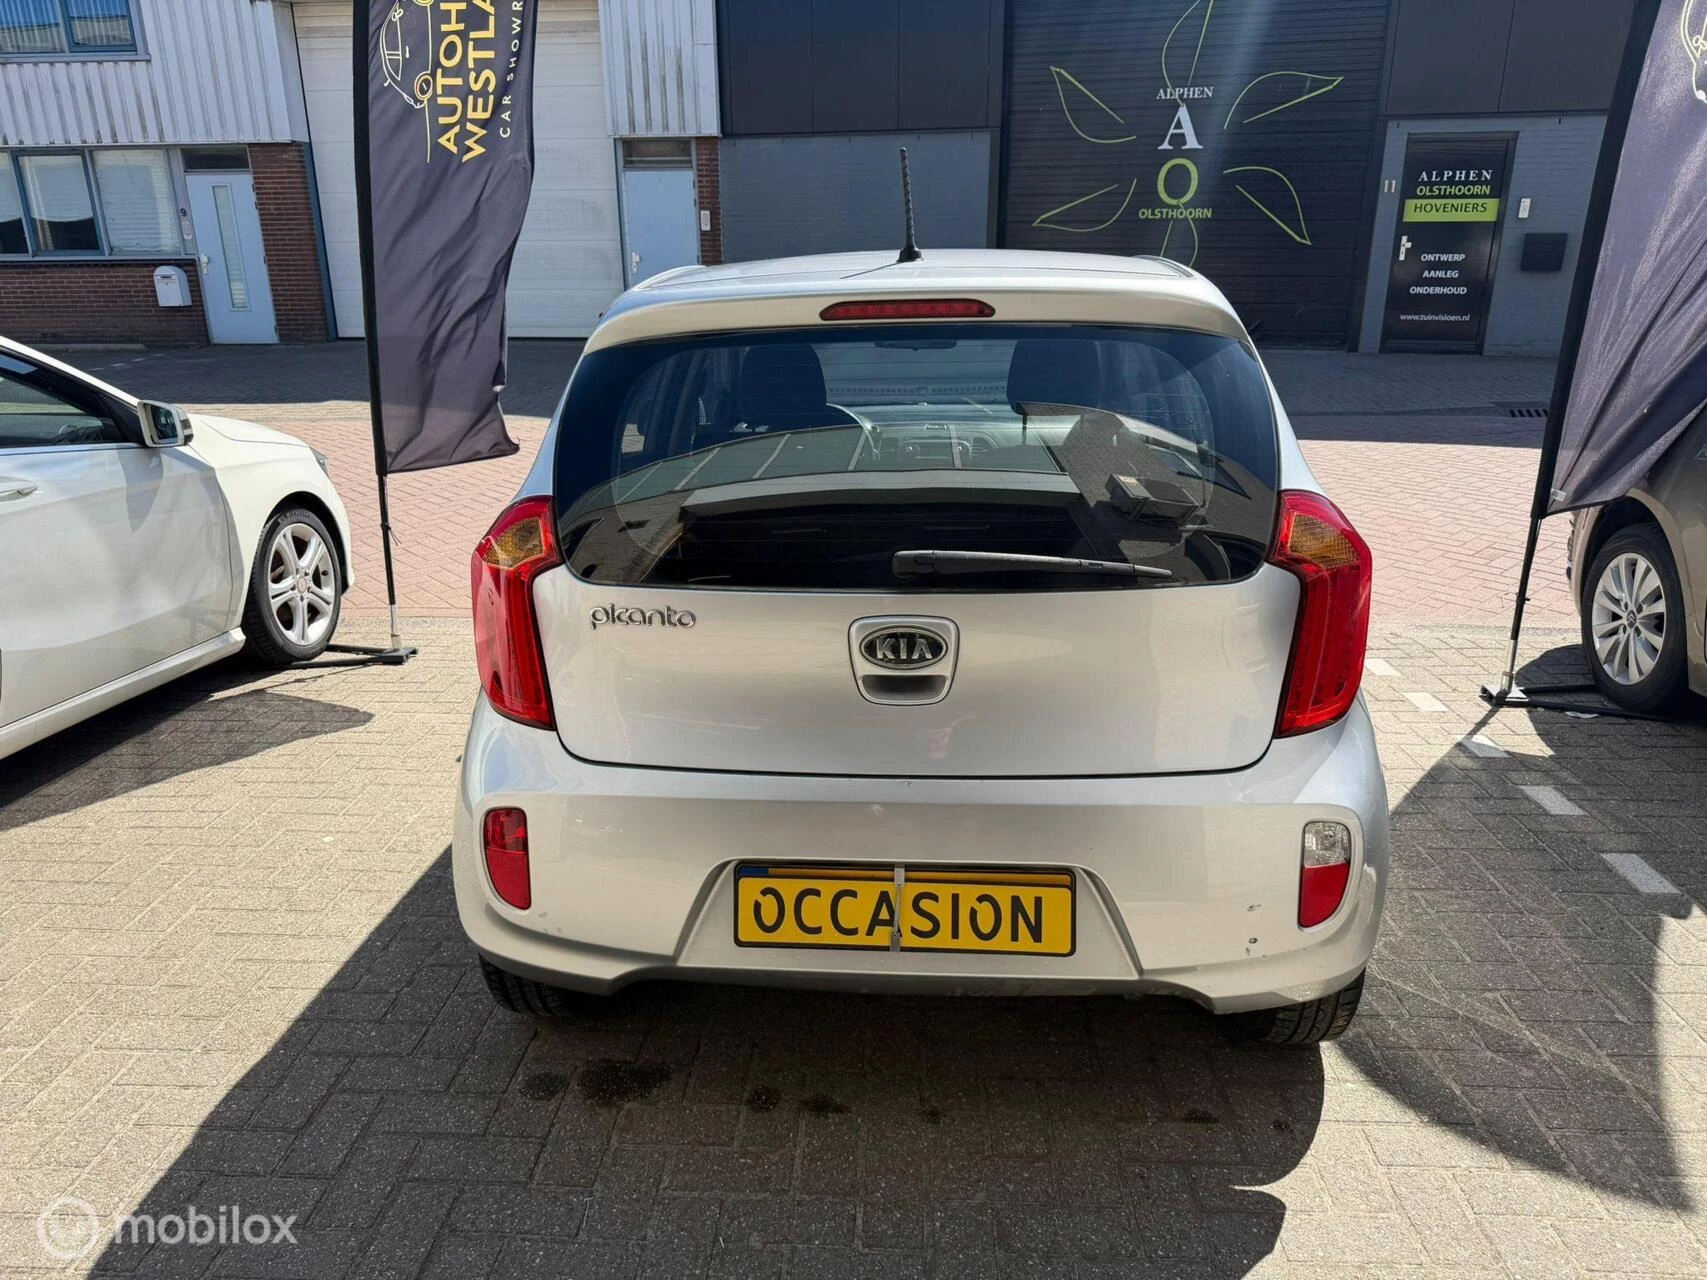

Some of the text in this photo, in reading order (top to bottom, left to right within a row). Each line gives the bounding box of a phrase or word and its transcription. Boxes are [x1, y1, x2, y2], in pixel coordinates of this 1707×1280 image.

[1156, 86, 1214, 99] ALPHEN
[500, 95, 512, 138] CAR
[1157, 103, 1204, 149] A
[1157, 158, 1198, 205] O
[1418, 170, 1493, 182] ALPHEN
[1416, 185, 1491, 196] OLSTHOORN
[180, 207, 187, 217] 9
[1138, 208, 1212, 219] OLSTHOORN
[1414, 202, 1488, 213] HOVENIERS
[1420, 253, 1466, 262] ONTWERP
[1422, 270, 1459, 278] AANLEG
[1409, 286, 1467, 295] ONDERHOUD
[589, 604, 696, 630] picanto
[875, 636, 933, 660] KIA
[753, 886, 1043, 944] OCCASION
